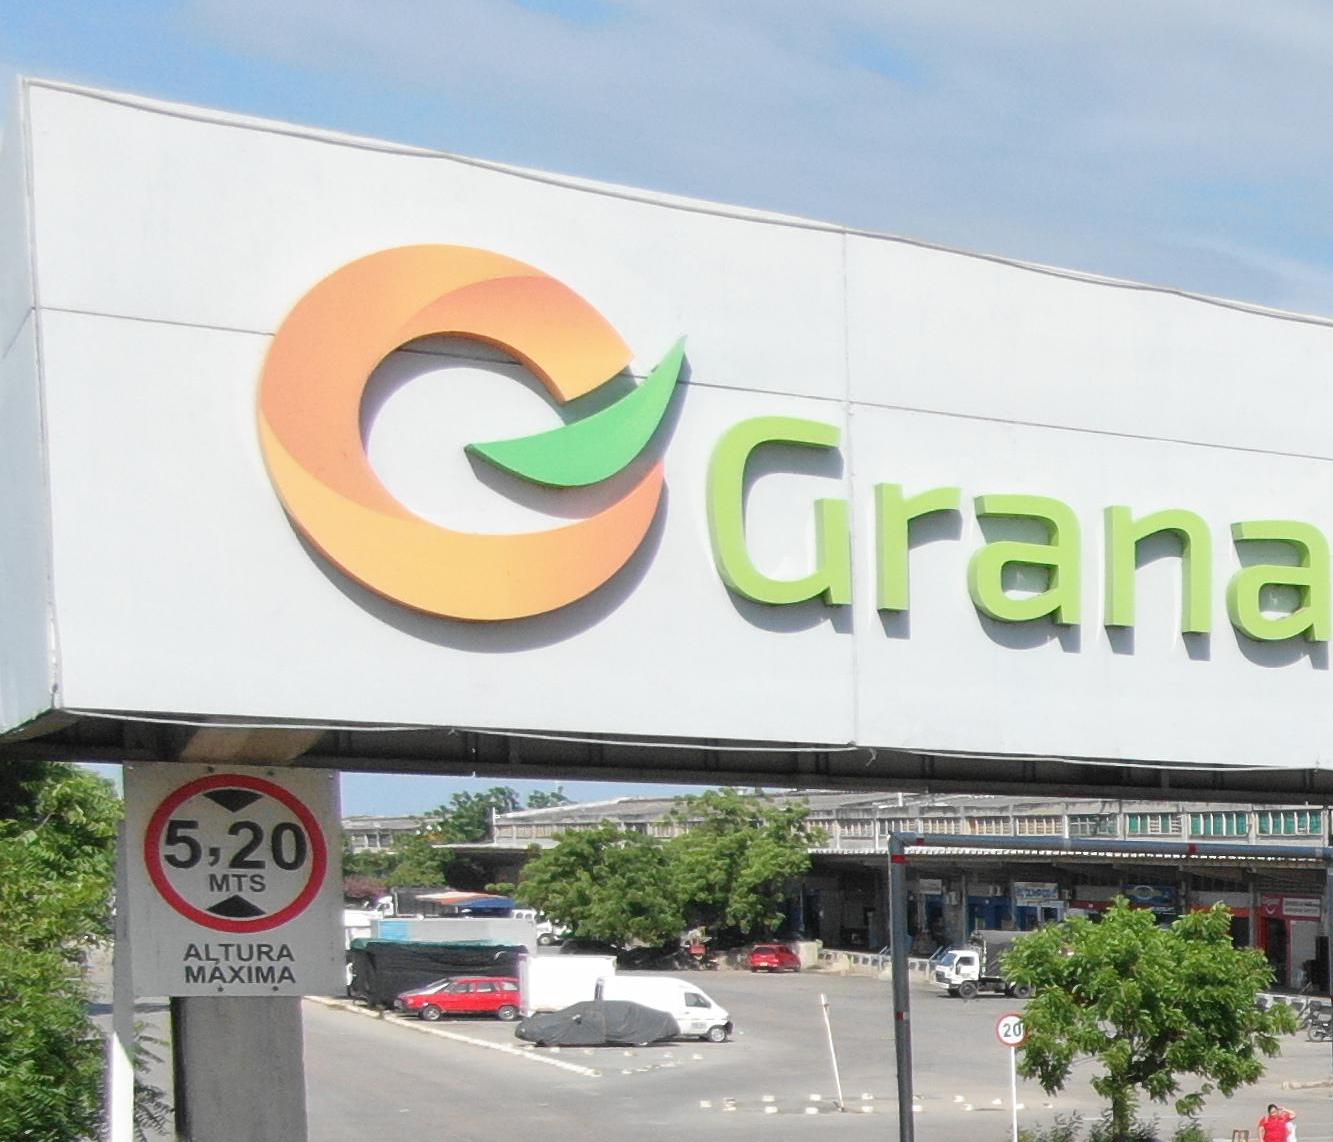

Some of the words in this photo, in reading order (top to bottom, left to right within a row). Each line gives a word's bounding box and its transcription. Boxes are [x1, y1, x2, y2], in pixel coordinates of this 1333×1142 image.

[163, 820, 308, 871] 5,20
[208, 873, 267, 893] MTS
[183, 943, 295, 962] ALTURA
[1003, 1023, 1022, 1038] 20
